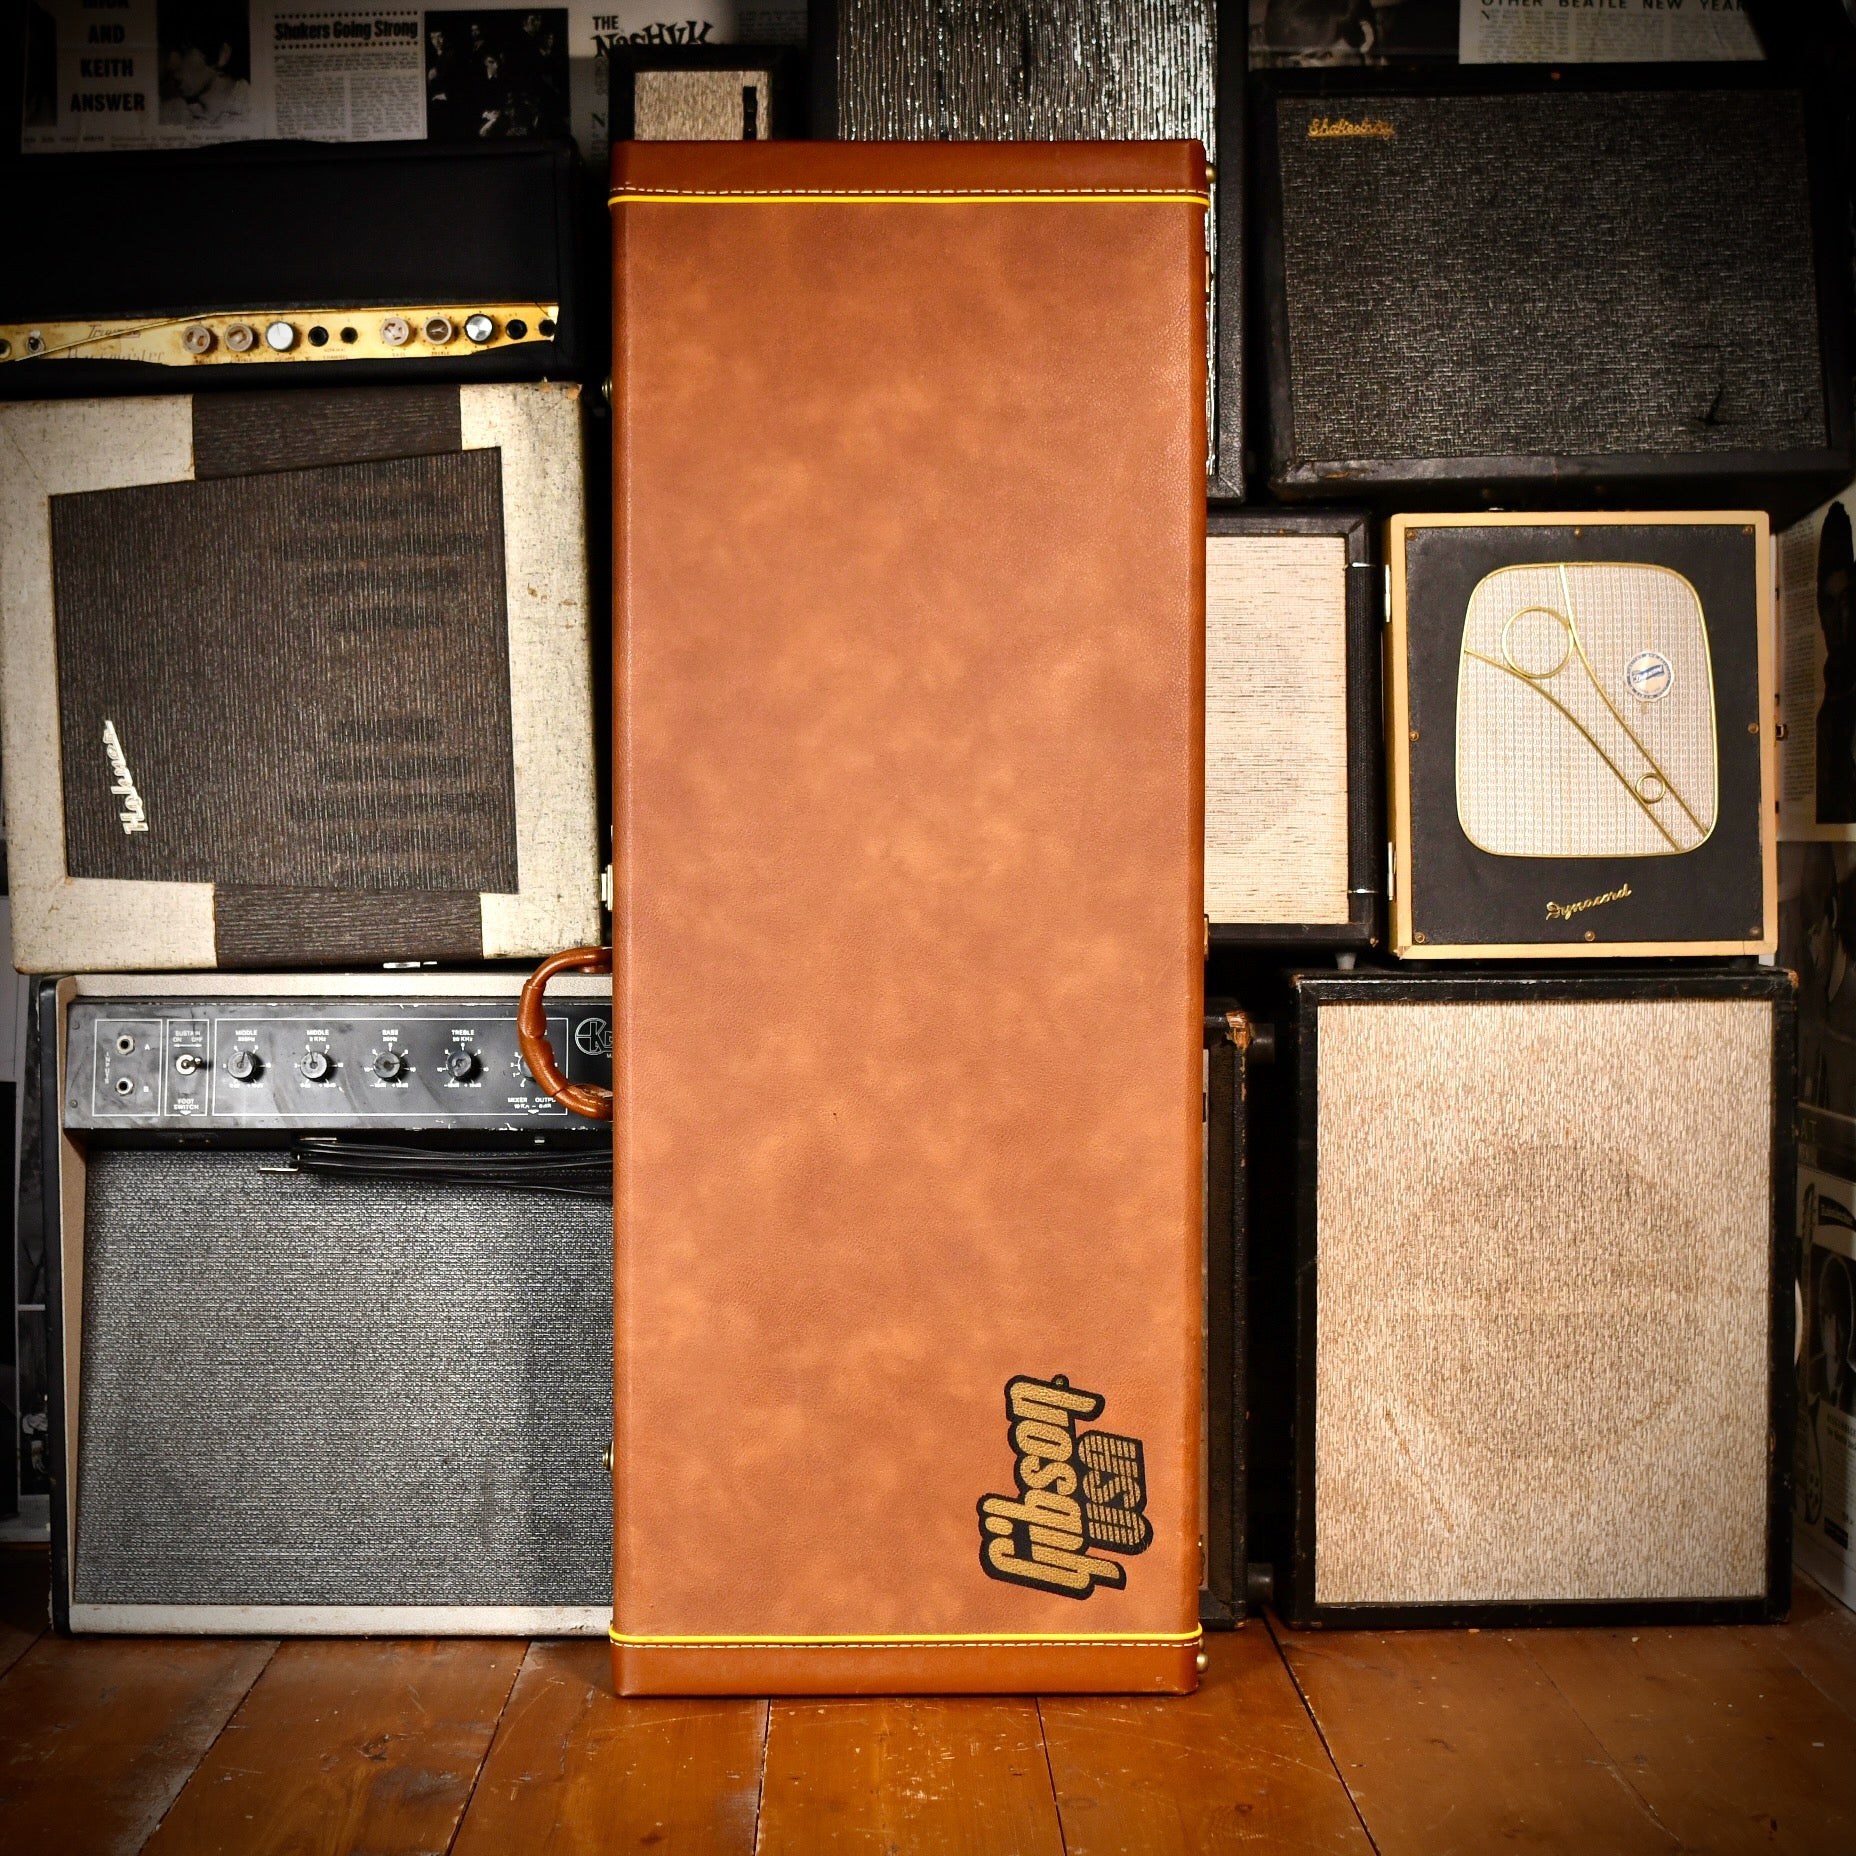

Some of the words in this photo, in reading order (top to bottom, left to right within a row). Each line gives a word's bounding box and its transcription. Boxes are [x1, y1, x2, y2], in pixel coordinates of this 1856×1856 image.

[275, 23, 330, 41] Shakers
[333, 21, 372, 40] Going
[374, 20, 418, 39] Strong
[592, 15, 619, 31] THE
[89, 24, 125, 44] AND
[81, 58, 134, 78] KEITH
[71, 93, 145, 112] ANSWER
[1545, 882, 1633, 921] Dynacord
[981, 1379, 1121, 1590] Gibson
[1077, 1433, 1147, 1547] USA
